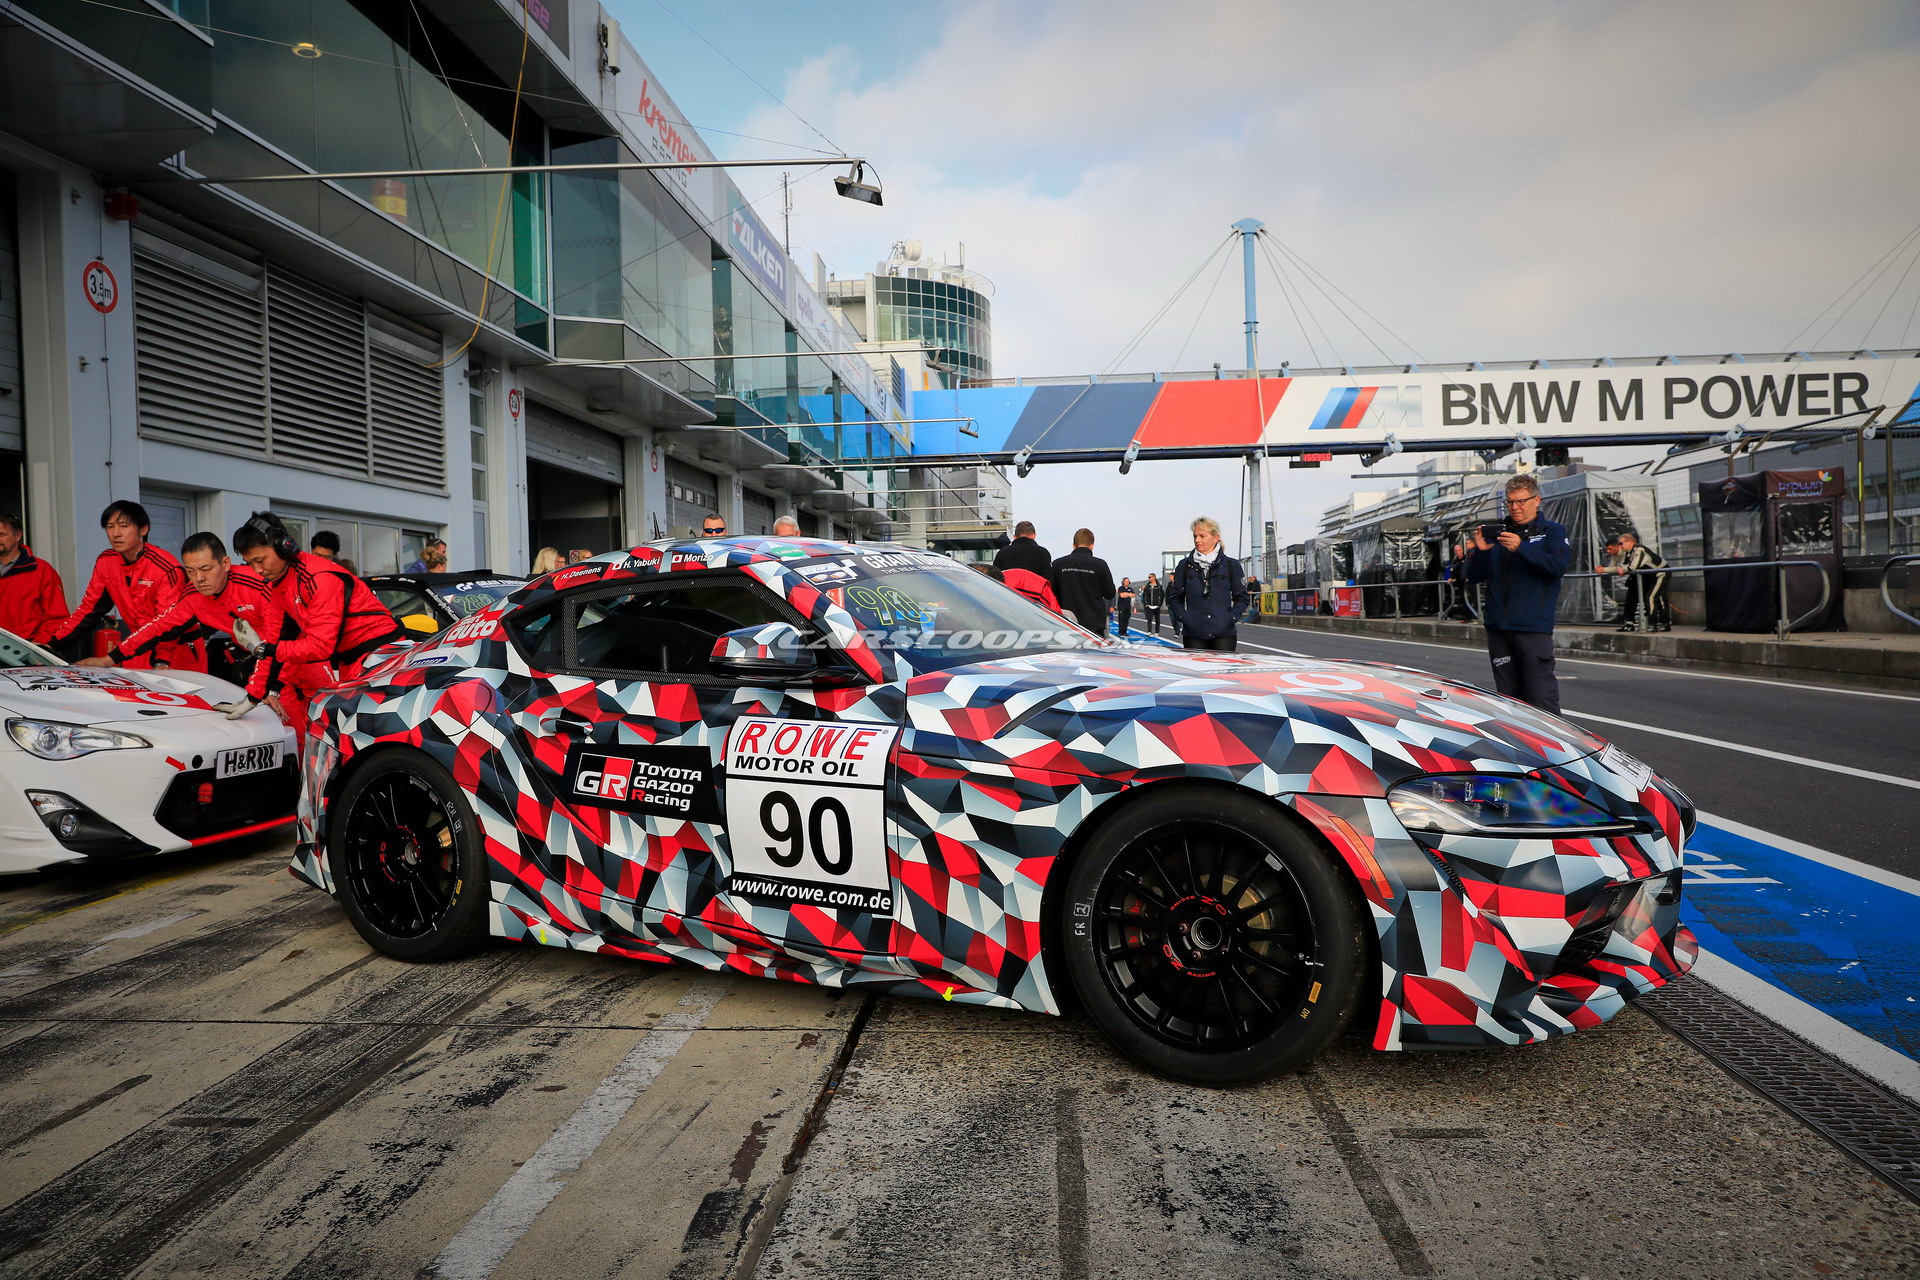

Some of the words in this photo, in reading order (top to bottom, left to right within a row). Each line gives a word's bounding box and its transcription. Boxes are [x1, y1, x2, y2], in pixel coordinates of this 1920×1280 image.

[638, 78, 698, 175] kremer
[732, 208, 784, 290] FALKEN
[1441, 380, 1581, 426] BMW
[1598, 378, 1645, 422] M
[1664, 371, 1870, 420] POWER
[1778, 481, 1825, 492] prowin
[623, 560, 633, 569] H.
[633, 556, 661, 568] Yabuki
[683, 553, 714, 562] Morizo
[861, 554, 913, 569] GRAN
[846, 585, 932, 626] 90
[446, 619, 499, 643] auto
[734, 721, 882, 761] ROWE
[224, 748, 257, 776] H&R
[636, 760, 703, 783] TOYOTA
[734, 755, 816, 775] MOTOR
[821, 760, 860, 778] OIL
[576, 770, 627, 799] GR
[632, 775, 695, 795] GAZOO
[631, 788, 692, 812] Racing
[758, 789, 854, 876] 90
[731, 877, 892, 911] www.rowe.com.de
[1187, 971, 1217, 979] RACING
